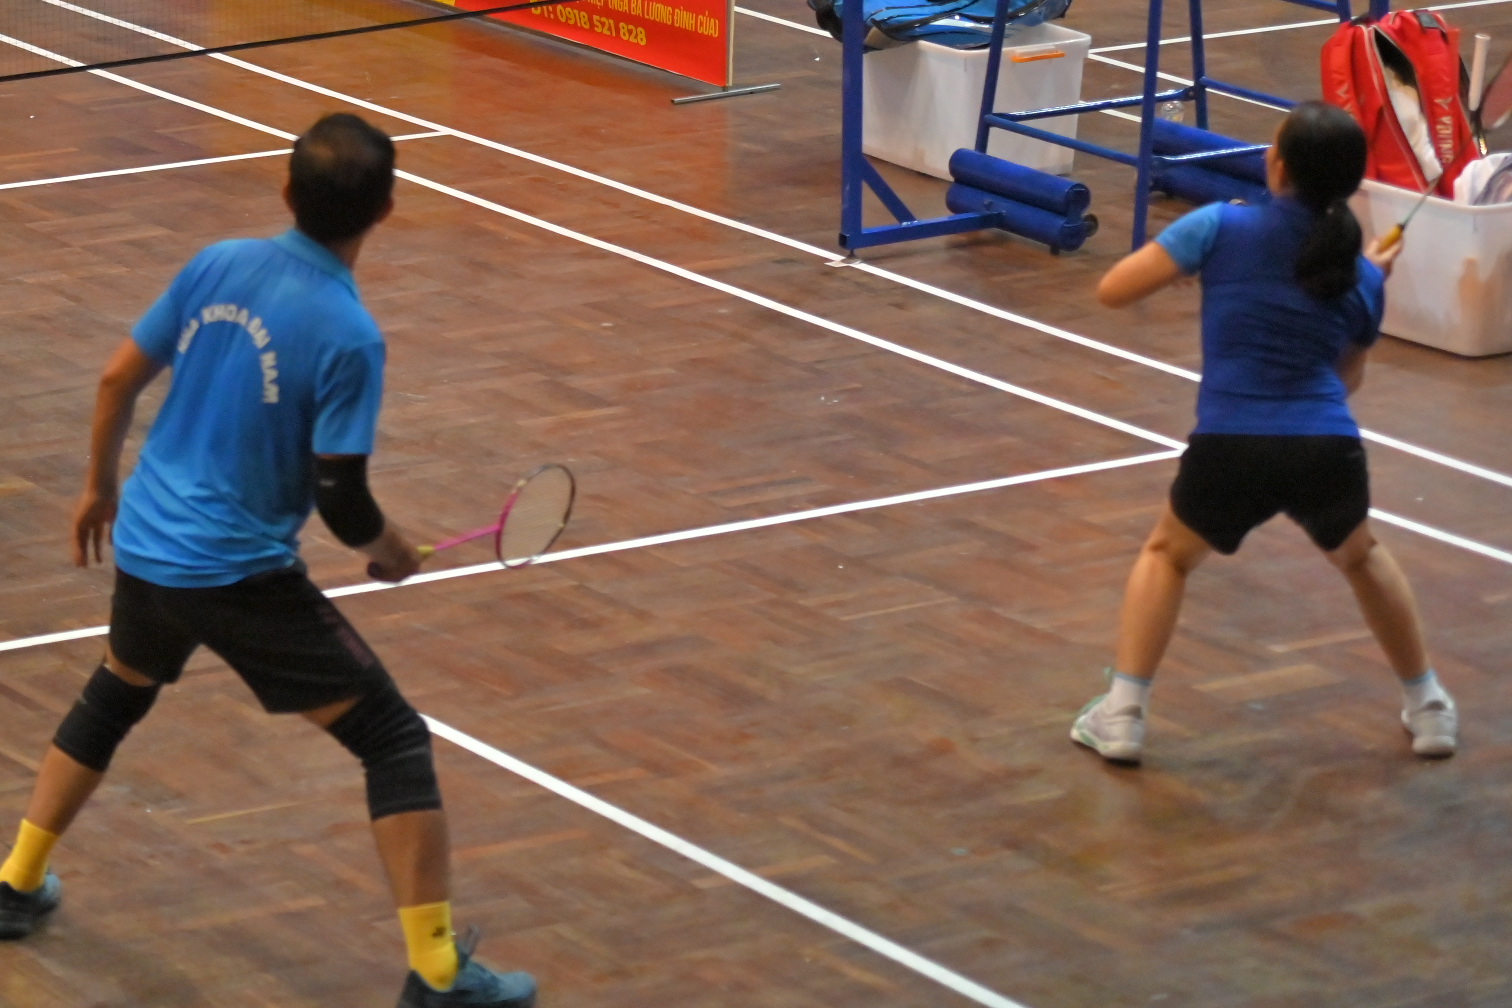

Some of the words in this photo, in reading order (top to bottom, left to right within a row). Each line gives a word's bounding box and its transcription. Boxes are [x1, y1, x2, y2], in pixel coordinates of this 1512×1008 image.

[556, 4, 590, 29] 0918
[593, 14, 615, 37] 521
[619, 22, 647, 45] 828
[644, 0, 673, 26] LƯƠNG
[674, 6, 696, 32] ĐÌNH
[697, 11, 719, 38] CỦA)
[201, 303, 249, 327] KHOA
[260, 351, 280, 403] NAM
